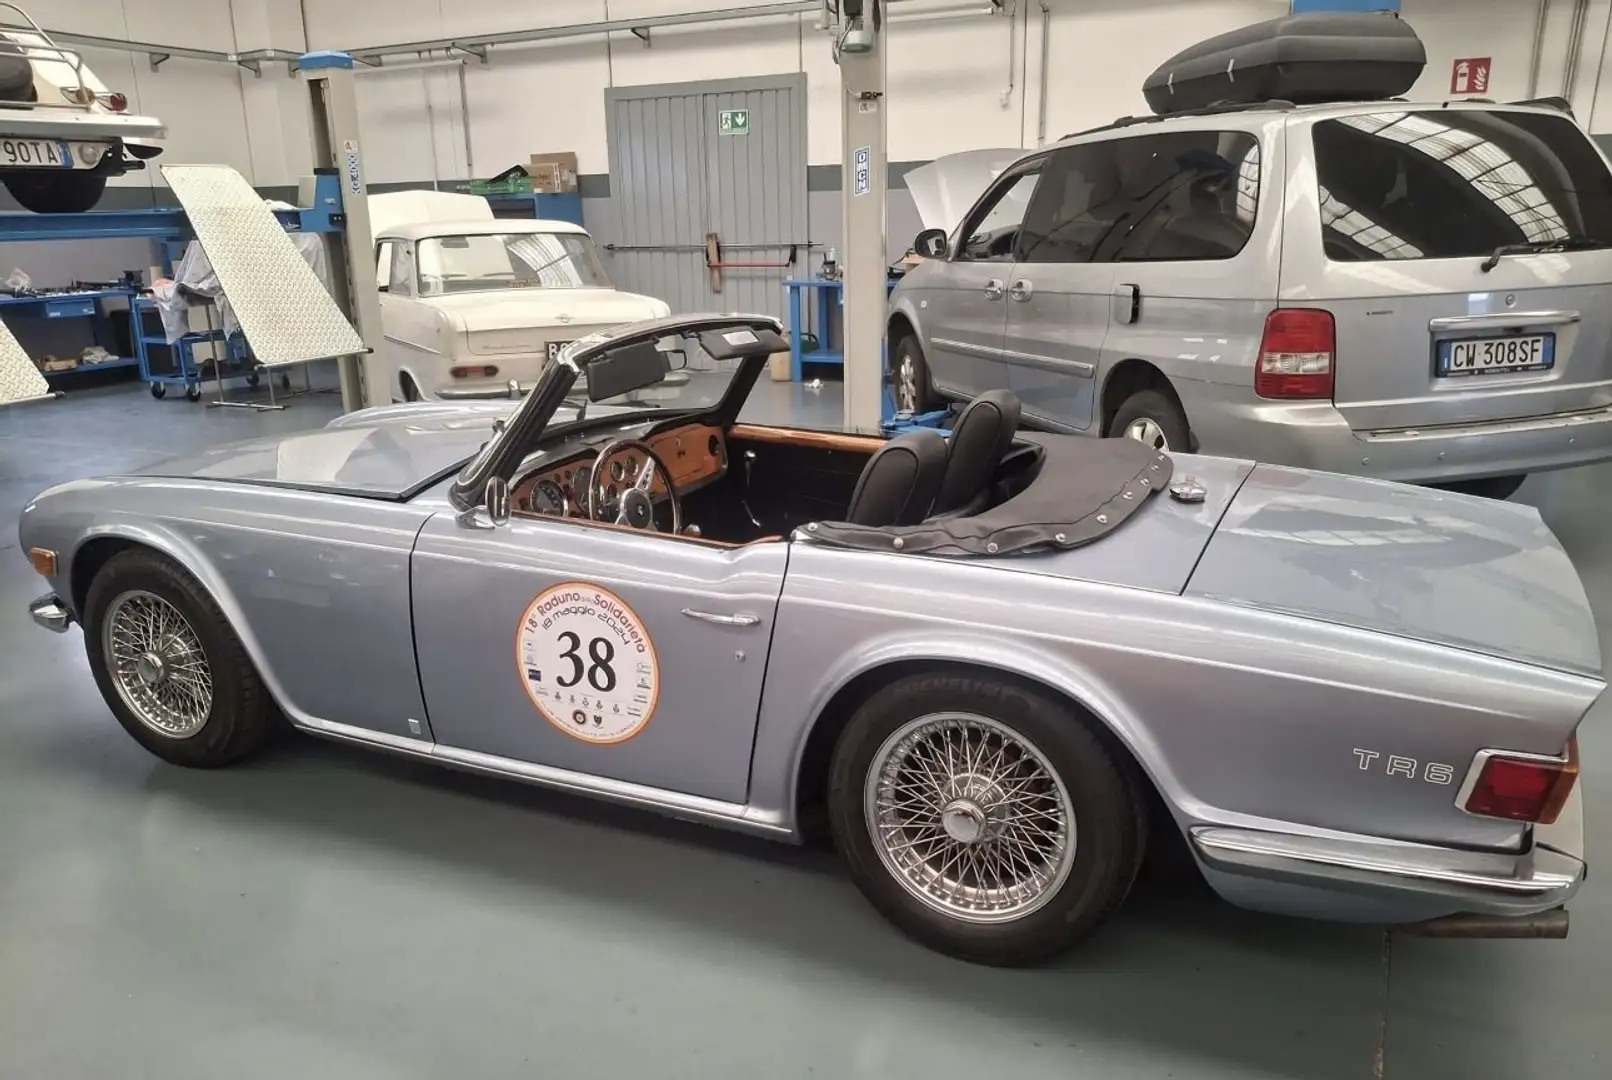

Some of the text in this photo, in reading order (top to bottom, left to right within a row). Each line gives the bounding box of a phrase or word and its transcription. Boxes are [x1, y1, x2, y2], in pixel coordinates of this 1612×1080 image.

[857, 151, 867, 191] OMCN
[1453, 344, 1476, 368] CW
[1483, 338, 1541, 366] 308SF
[537, 592, 580, 616] Raduno
[552, 606, 596, 621] maggio
[597, 613, 630, 645] 2024
[556, 631, 616, 692] 38
[1353, 748, 1454, 785] TR6
